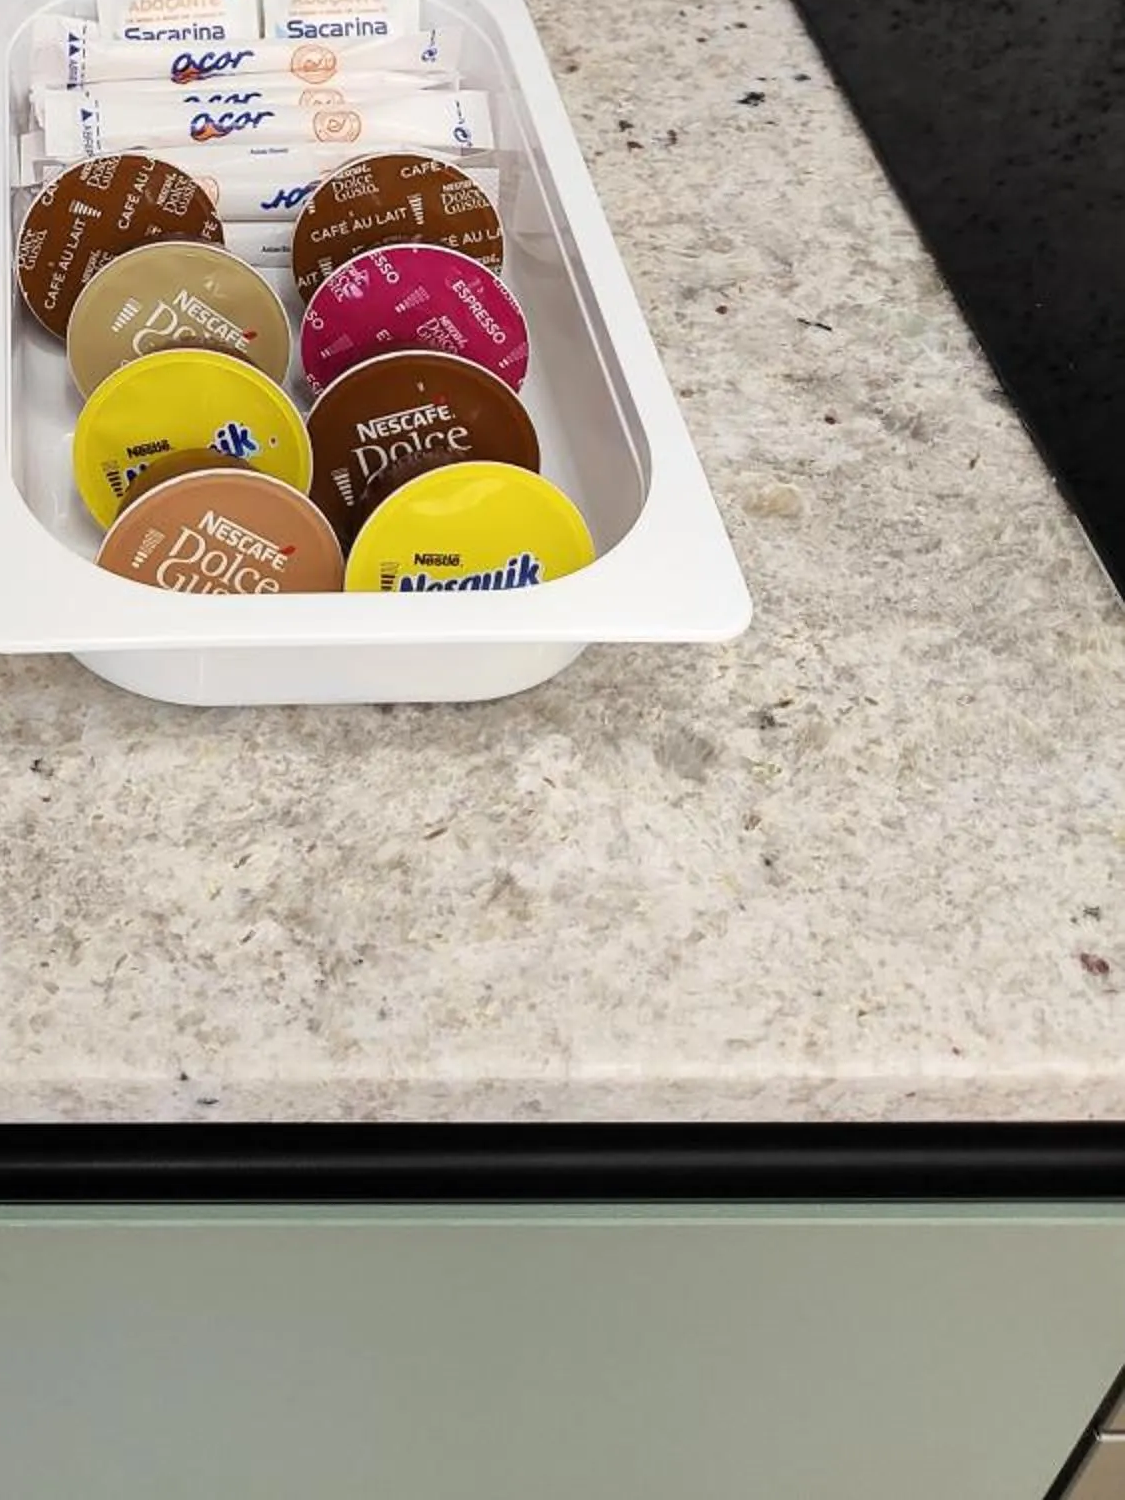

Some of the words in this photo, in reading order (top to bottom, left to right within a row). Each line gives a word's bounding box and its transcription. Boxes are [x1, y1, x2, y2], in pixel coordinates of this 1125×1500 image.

[287, 17, 388, 39] Sacarina
[133, 172, 150, 194] AU
[331, 174, 374, 192] Dolce
[335, 184, 377, 203] Gusto
[352, 215, 373, 232] AU
[375, 207, 407, 225] LAIT
[66, 217, 86, 250] LAIT
[462, 231, 484, 246] AU
[59, 249, 75, 271] AU
[452, 279, 506, 344] ESPRESSO
[351, 424, 473, 486] Dolce
[169, 525, 280, 595] Dolce
